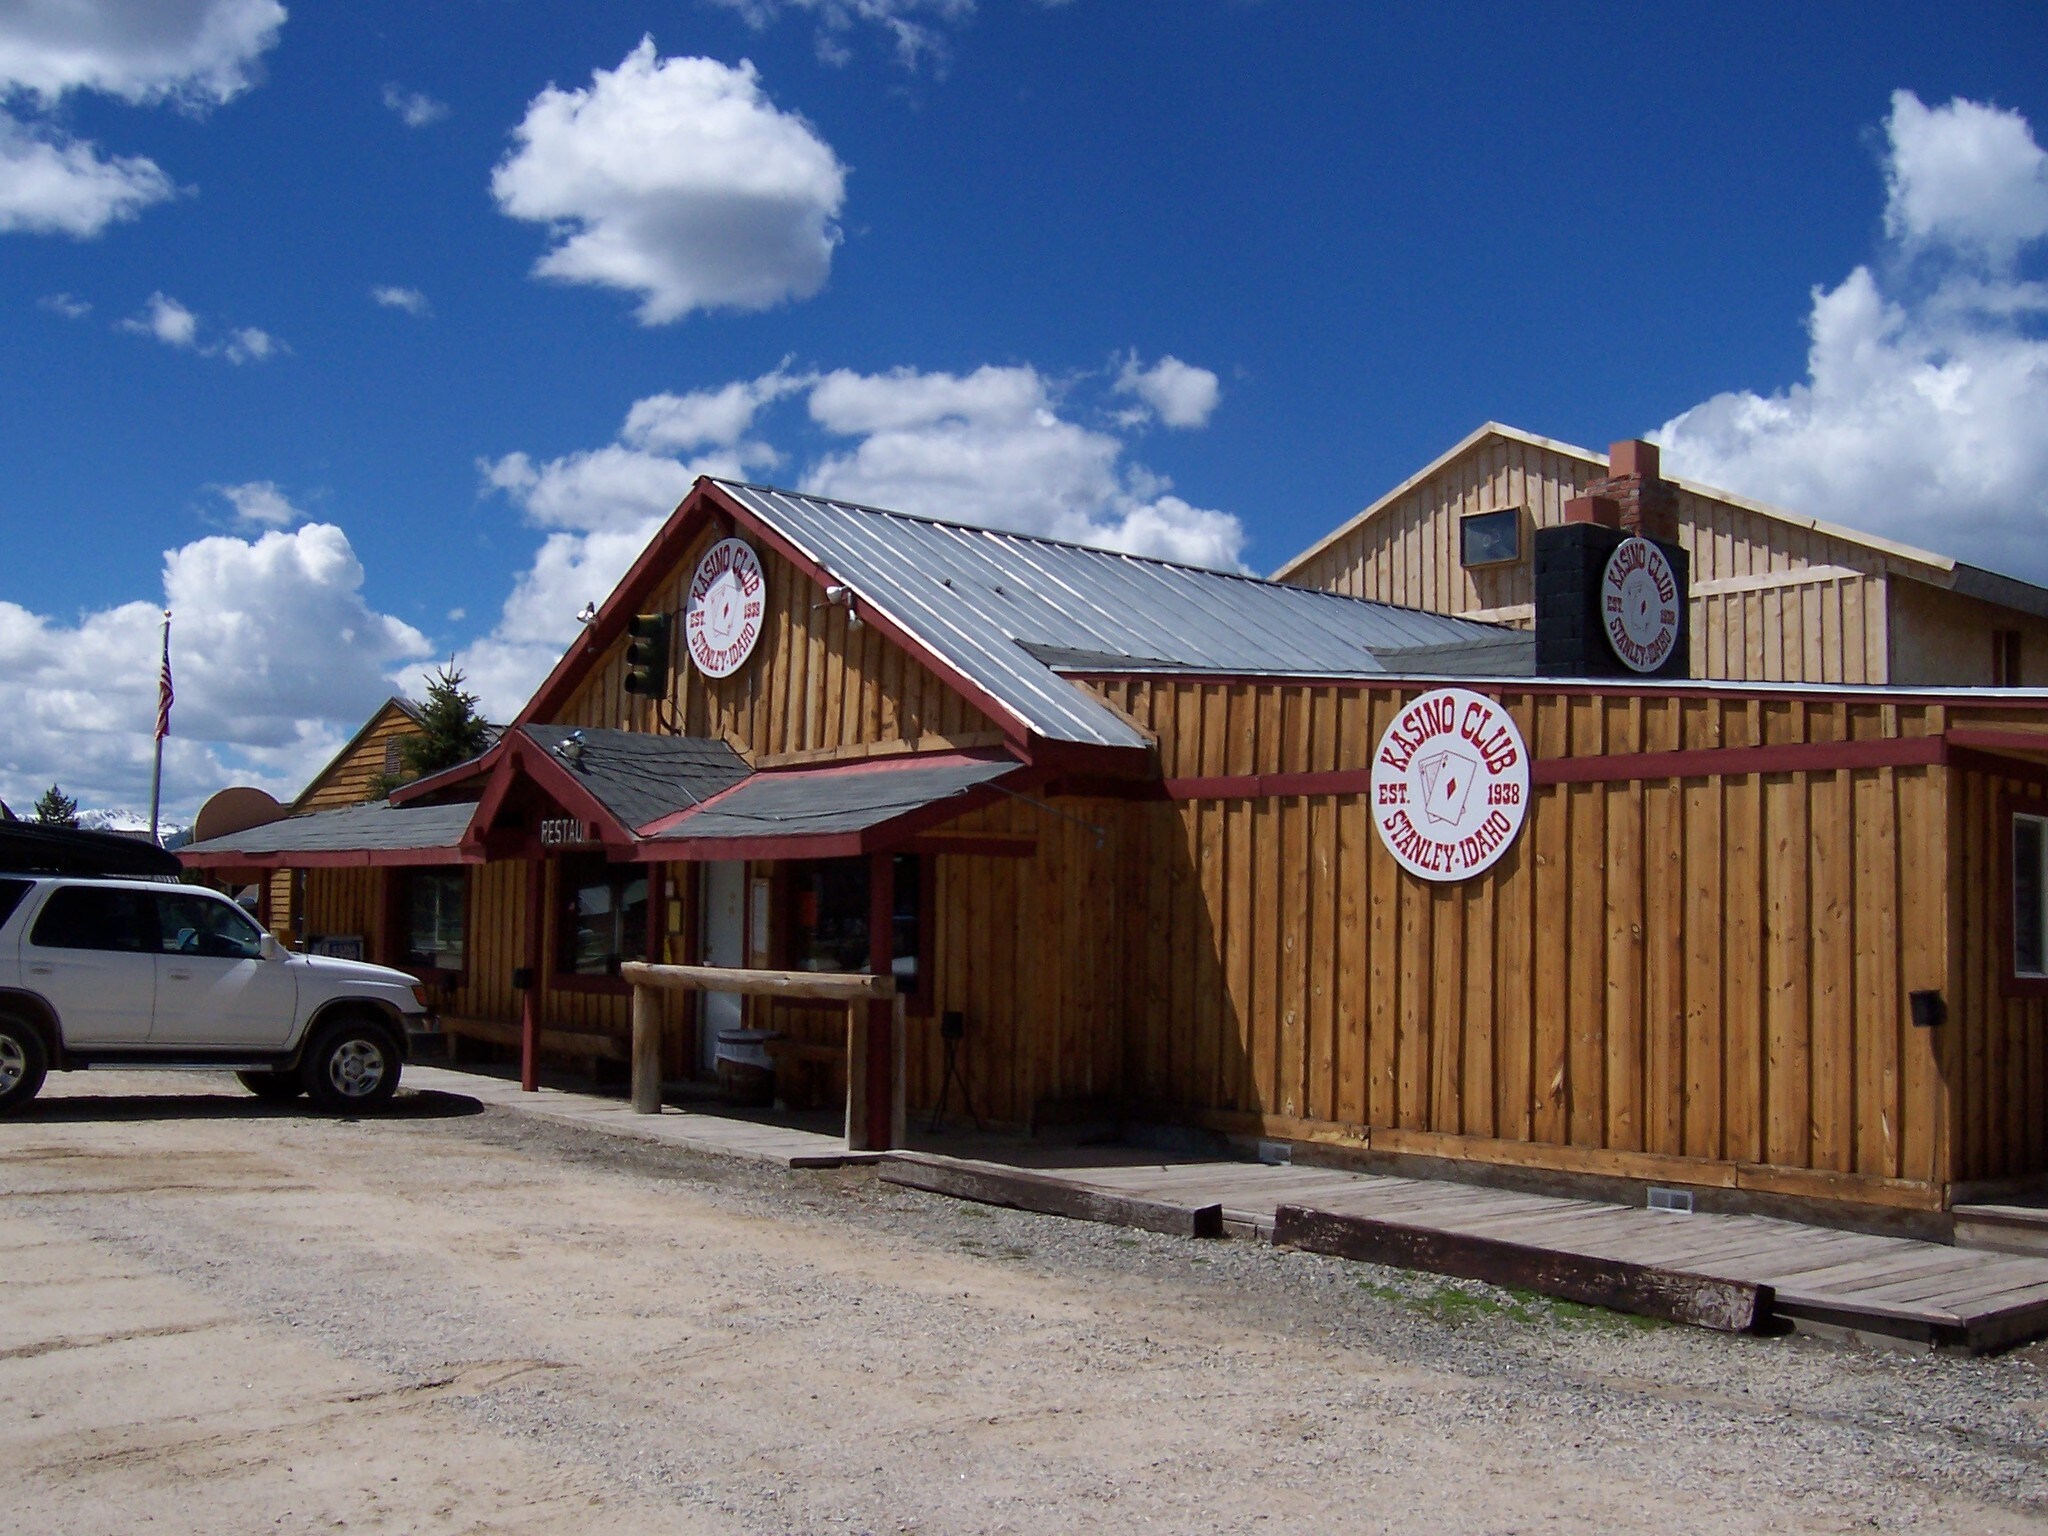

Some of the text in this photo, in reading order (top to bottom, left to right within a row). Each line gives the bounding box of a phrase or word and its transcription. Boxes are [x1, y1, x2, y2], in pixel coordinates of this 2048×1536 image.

[691, 544, 760, 603] KASINO CLUB
[1608, 542, 1674, 604] KASINO CLUB
[691, 622, 755, 671] STANLEY IDAHO
[1380, 695, 1518, 775] KASINO CLUB
[1378, 783, 1520, 805] EST. 1938
[541, 818, 584, 844] RESTAU
[1383, 809, 1511, 872] STANLEY IDAHO
